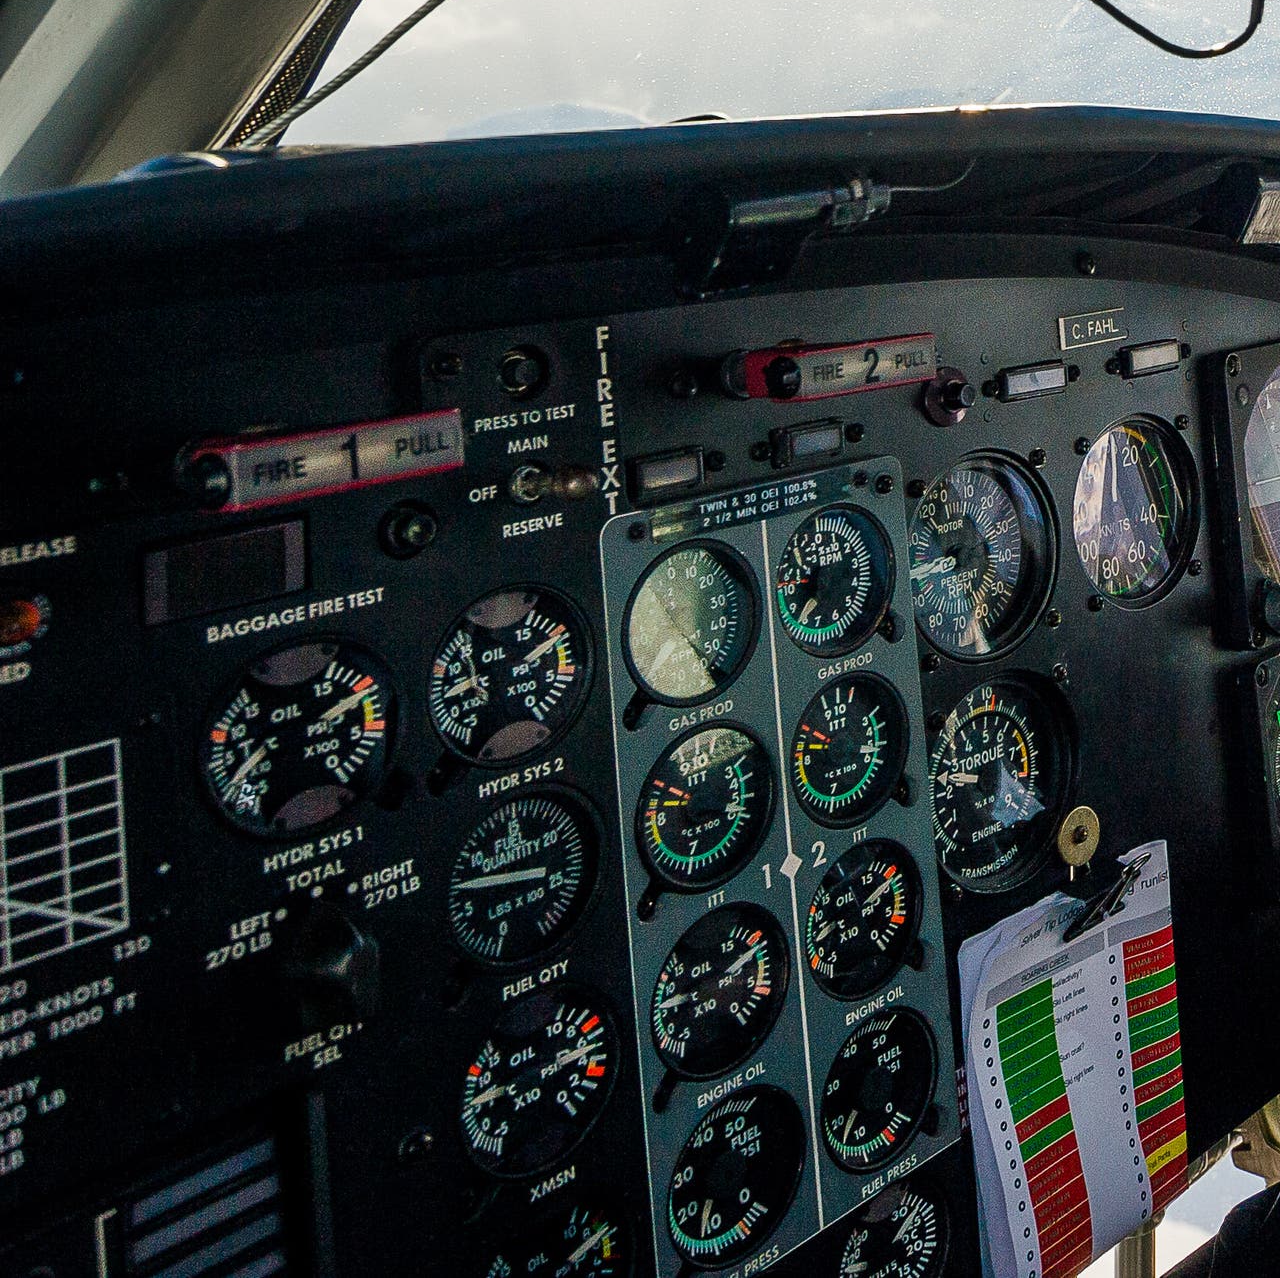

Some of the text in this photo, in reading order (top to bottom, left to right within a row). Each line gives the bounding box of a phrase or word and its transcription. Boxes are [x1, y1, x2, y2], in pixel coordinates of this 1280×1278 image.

[1072, 318, 1119, 339] C. FAHL
[812, 348, 928, 384] FIRE 2 PULL
[473, 403, 576, 434] PRESS TO TEST
[595, 325, 621, 516] FIRE EXT
[506, 434, 549, 455] MAIN
[251, 431, 450, 487] FIRE 1 PULL
[468, 485, 498, 504] OFF
[700, 498, 729, 514] TWIN
[731, 498, 740, 509] &
[743, 493, 757, 505] 30
[714, 511, 732, 525] 1/2
[736, 506, 757, 521] MIN
[1139, 503, 1158, 524] 40
[502, 513, 564, 539] RESERVE
[937, 518, 964, 534] ROTOR
[818, 552, 843, 567] RPM
[1127, 540, 1146, 563] 60
[940, 568, 979, 588] PERCENT
[948, 582, 973, 599] RPM
[206, 586, 386, 644] BAGGAGE FIRE TEST
[481, 648, 507, 664] OIL
[817, 652, 874, 680] GAS PROD
[506, 681, 537, 697] X100
[270, 703, 302, 723] OIL
[668, 699, 735, 732] GAS PROD
[829, 716, 847, 732] ITT
[303, 738, 340, 759] X100
[958, 743, 1005, 774] TORQUE
[478, 757, 565, 799] HYDR SYS 2
[687, 771, 708, 787] ITT
[704, 818, 721, 832] 100
[853, 827, 868, 844] ITT
[971, 821, 1003, 844] ENGINE
[263, 826, 364, 874] HYDR SYS 1
[494, 832, 523, 854] FUEL
[481, 839, 542, 873] QUANTITY
[762, 840, 827, 890] 1 2
[959, 844, 1018, 879] TRANSMISSION
[285, 859, 346, 893] TOTAL
[361, 858, 416, 891] RIGHT
[1141, 870, 1168, 890] runlist
[364, 875, 421, 910] 270 LB
[487, 886, 545, 920] LBS X 100
[707, 890, 725, 908] ITT
[229, 911, 271, 940] LEFT
[839, 925, 859, 943] X10
[112, 935, 152, 962] 130
[1020, 928, 1043, 949] Silver
[205, 931, 273, 972] 270 LB
[502, 959, 569, 1002] FUEL QTY
[690, 960, 713, 979] OIL
[1020, 962, 1049, 984] ROARING
[1049, 953, 1070, 971] CREEK
[49, 1004, 104, 1040] 1000
[113, 991, 138, 1015] FT
[693, 998, 717, 1018] X10
[845, 986, 905, 1026] ENGINE OIL
[283, 1032, 326, 1063] FUEL
[312, 1045, 344, 1071] SEL
[509, 1046, 536, 1067] OIL
[877, 1045, 903, 1067] FUEL
[697, 1061, 766, 1109] ENGINE OIL
[38, 1088, 67, 1115] LB
[514, 1088, 541, 1112] X10
[693, 1128, 714, 1149] 40
[724, 1116, 746, 1139] 50
[730, 1125, 762, 1150] FUEL
[529, 1165, 577, 1204] XMSN
[673, 1166, 694, 1189] 30
[861, 1154, 918, 1199] FUEL PRESS
[677, 1201, 698, 1224] 20
[744, 1245, 780, 1275] PRESS
